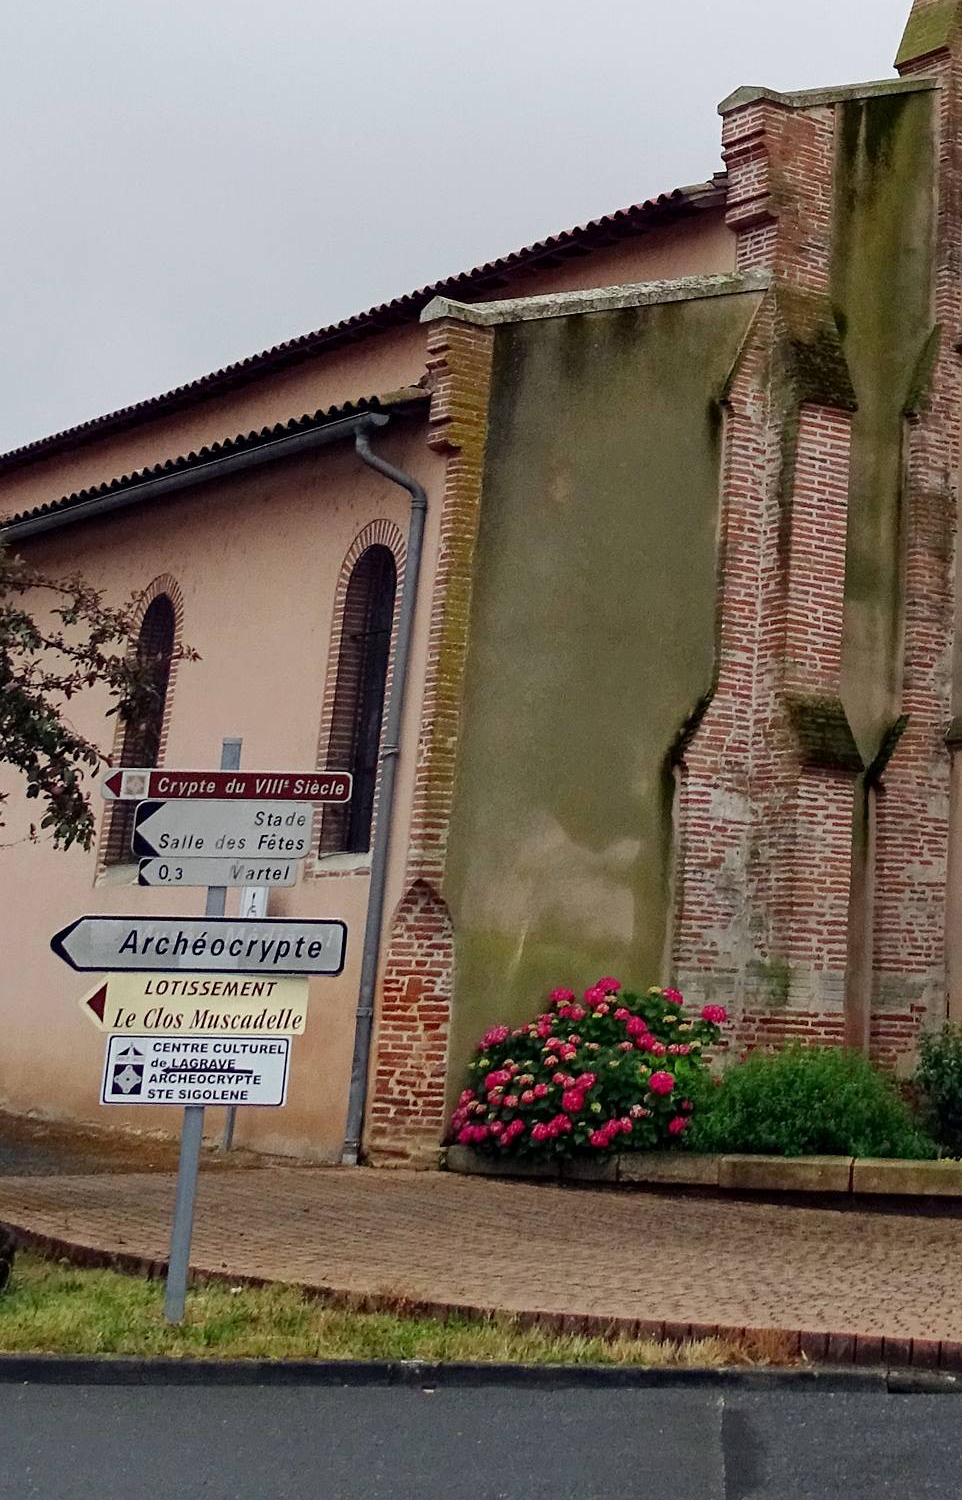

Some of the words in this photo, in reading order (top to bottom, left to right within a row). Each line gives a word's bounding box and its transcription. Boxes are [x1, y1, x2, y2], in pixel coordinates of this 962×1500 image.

[157, 777, 216, 796] Crypte
[225, 778, 246, 794] du
[293, 780, 345, 796] Siècle
[254, 811, 306, 827] Stade
[158, 833, 204, 850] Salle
[215, 835, 246, 850] des
[257, 833, 305, 851] Fêtes
[118, 930, 323, 964] Archéocrypte
[144, 980, 277, 997] LOTISSEMENT
[113, 1007, 137, 1029] Le
[143, 1008, 184, 1030] Clos
[189, 1009, 304, 1030] Muscadelle
[152, 1042, 209, 1053] CENTRE
[212, 1044, 285, 1055] CULTUREL
[150, 1057, 168, 1069] de
[171, 1058, 237, 1070] LAGRAVE
[148, 1073, 262, 1085] ARCHEOCRYPTE
[147, 1088, 175, 1100] STE
[178, 1089, 249, 1101] SIGOLENE
